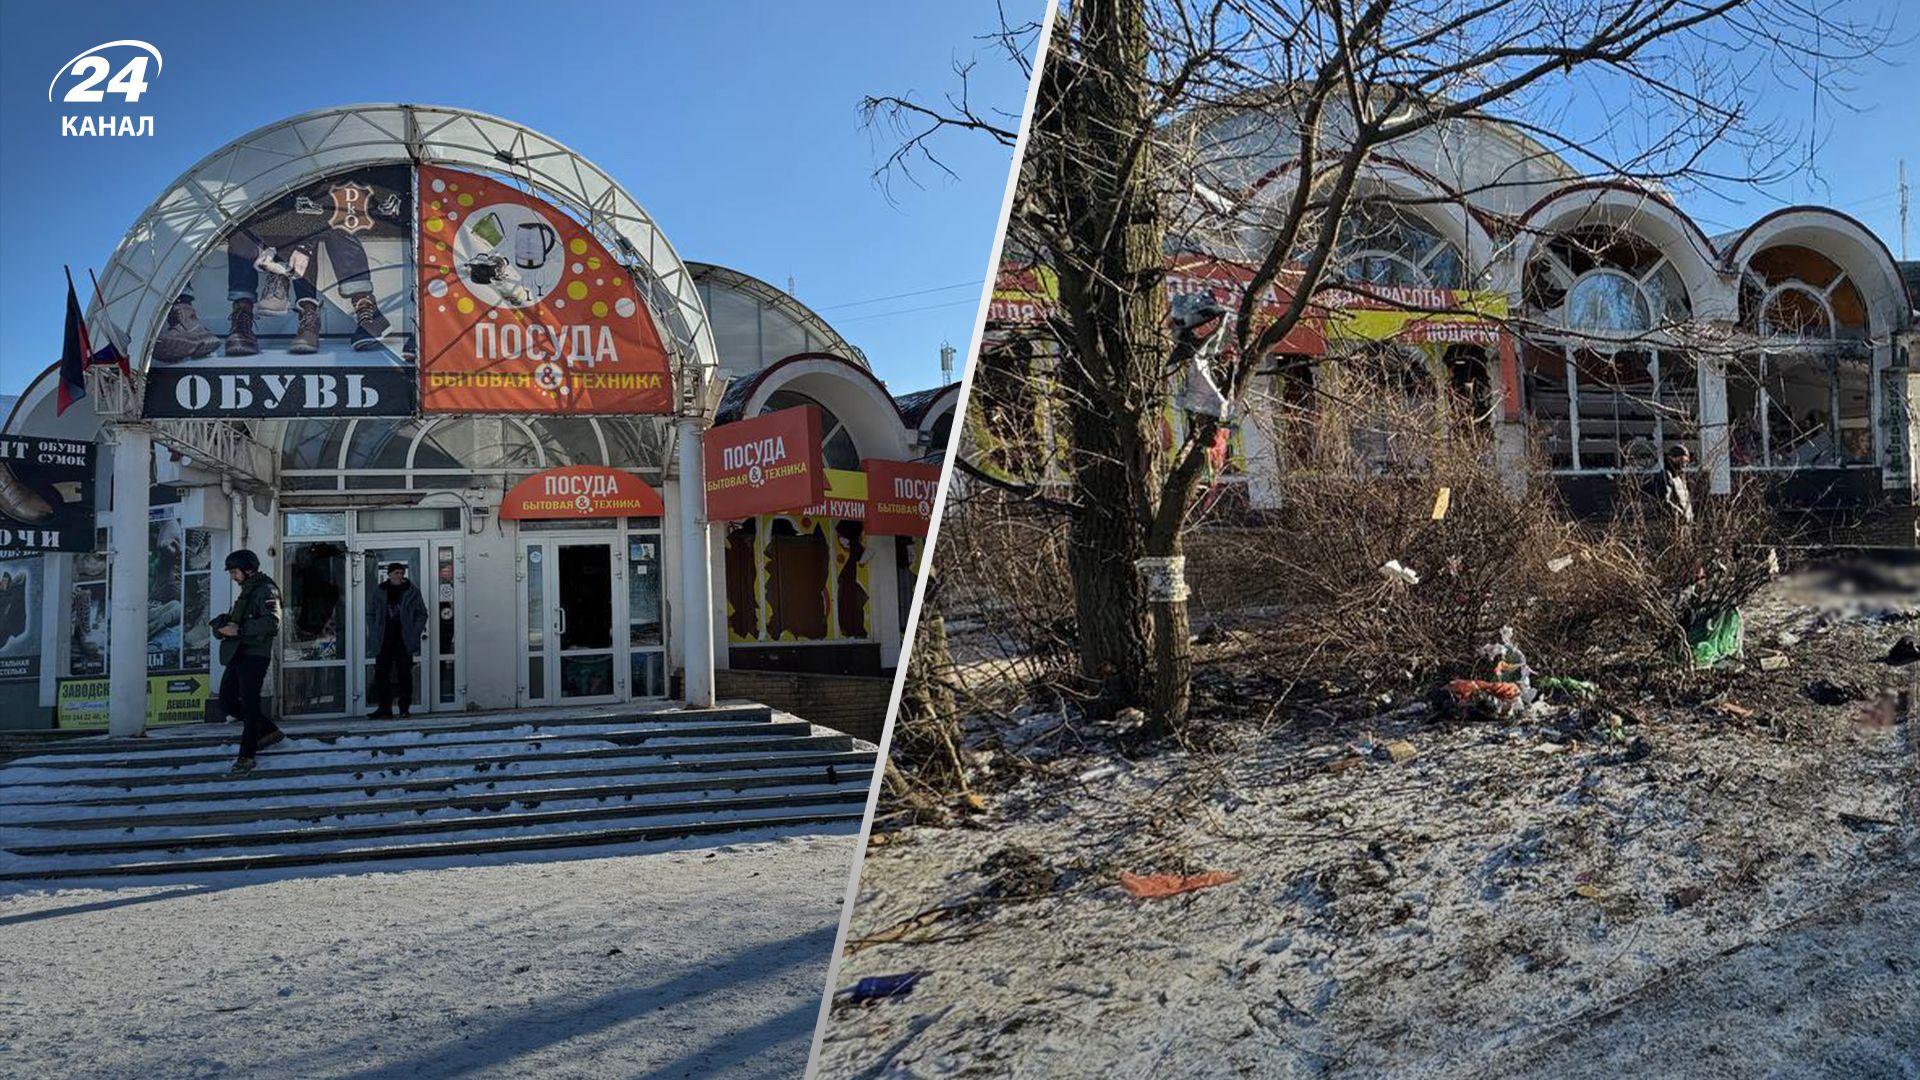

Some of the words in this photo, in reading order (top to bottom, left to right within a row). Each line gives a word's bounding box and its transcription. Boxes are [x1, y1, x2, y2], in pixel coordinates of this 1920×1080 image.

[474, 322, 619, 368] ПОСУДА
[430, 370, 531, 389] БЫТОВАЯ
[570, 371, 662, 390] ТЕХНИКА
[175, 374, 379, 410] ОБУВЬ
[38, 441, 86, 454] ОБУВИ
[724, 436, 786, 471] ПОСУДА
[37, 453, 86, 467] СУМОК
[545, 475, 619, 498] ПОСУДА
[706, 473, 748, 492] БЫТОВАЯ
[764, 462, 808, 481] ТЕХНИКА
[522, 500, 573, 511] БЫТОВАЯ
[594, 499, 641, 510] ТЕХНИКА
[829, 500, 866, 518] КУХНИ
[877, 502, 918, 515] БЫТОВАЯ
